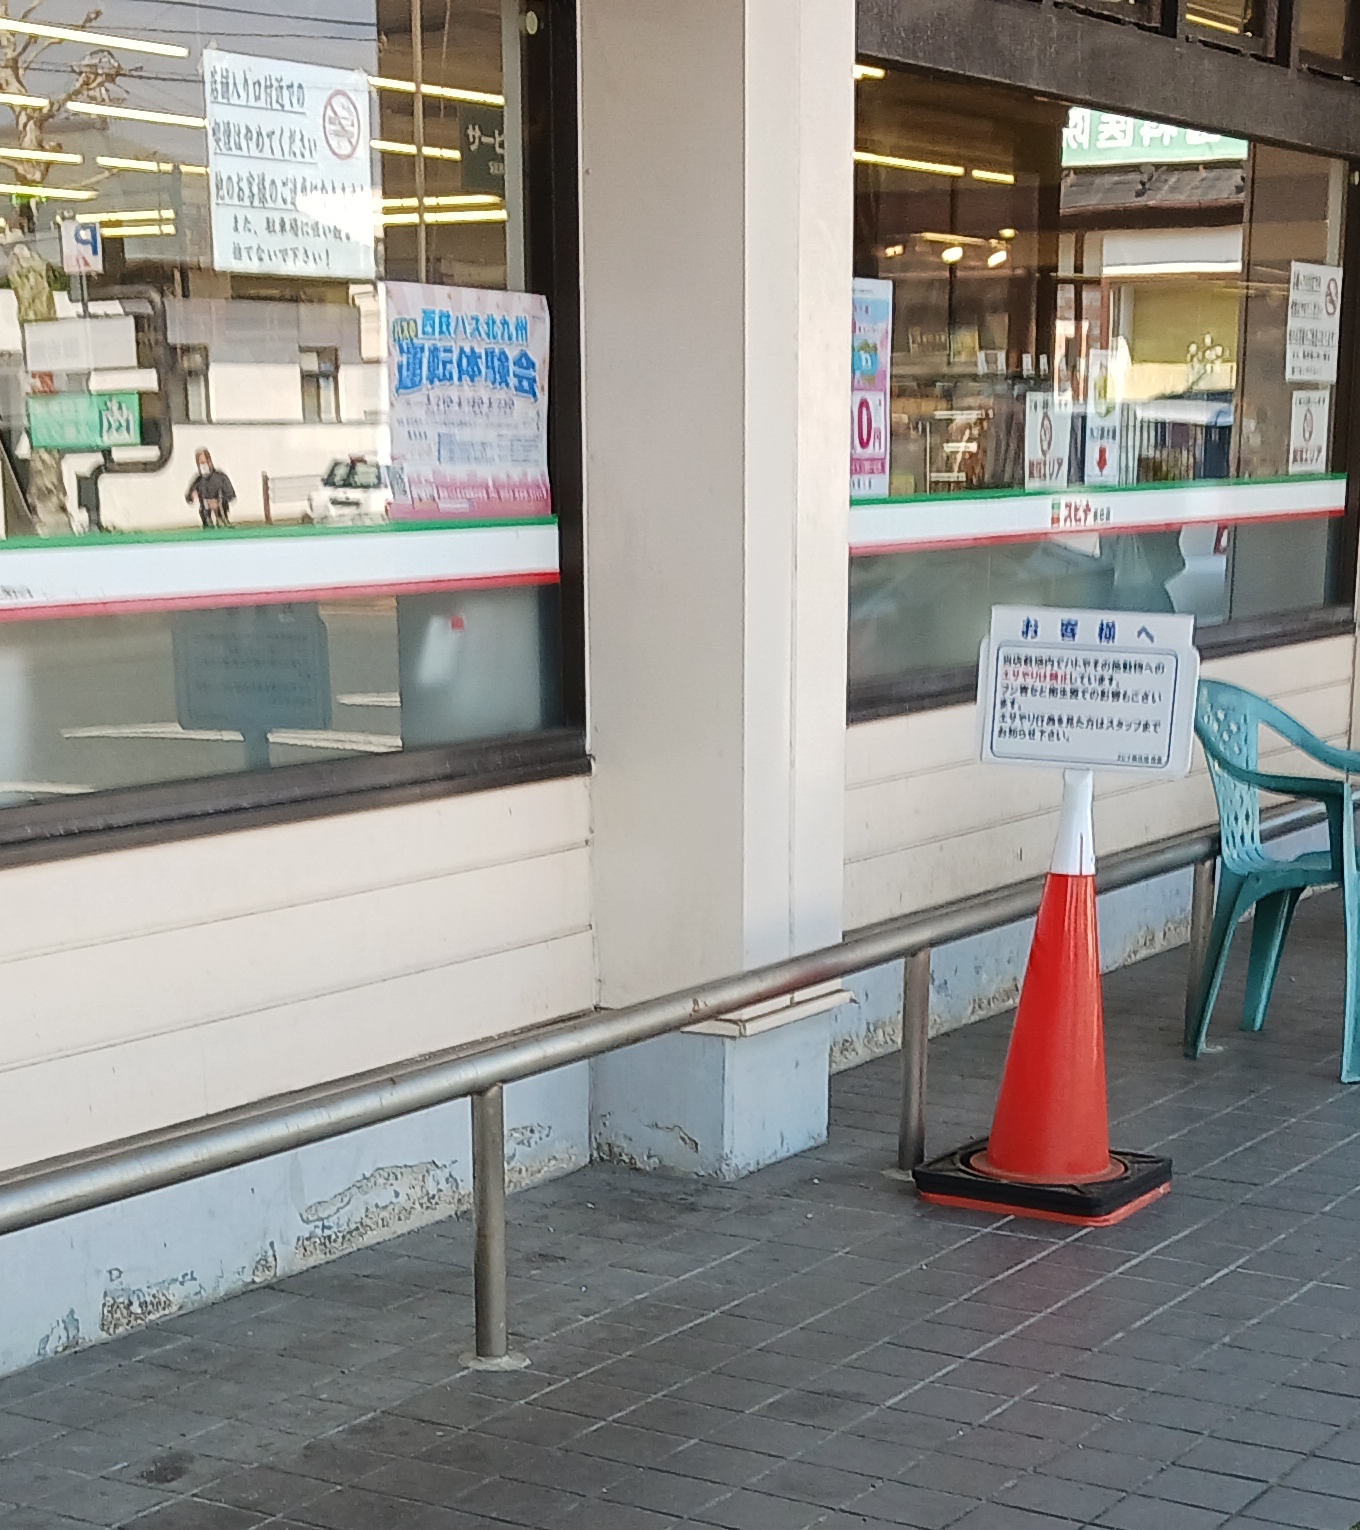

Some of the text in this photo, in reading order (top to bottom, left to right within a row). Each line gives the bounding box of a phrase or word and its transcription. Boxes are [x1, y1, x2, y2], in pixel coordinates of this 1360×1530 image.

[421, 307, 529, 345] 西鉄バス北九州
[396, 341, 538, 400] 運転体験会
[1021, 616, 1155, 645] お客様へ
